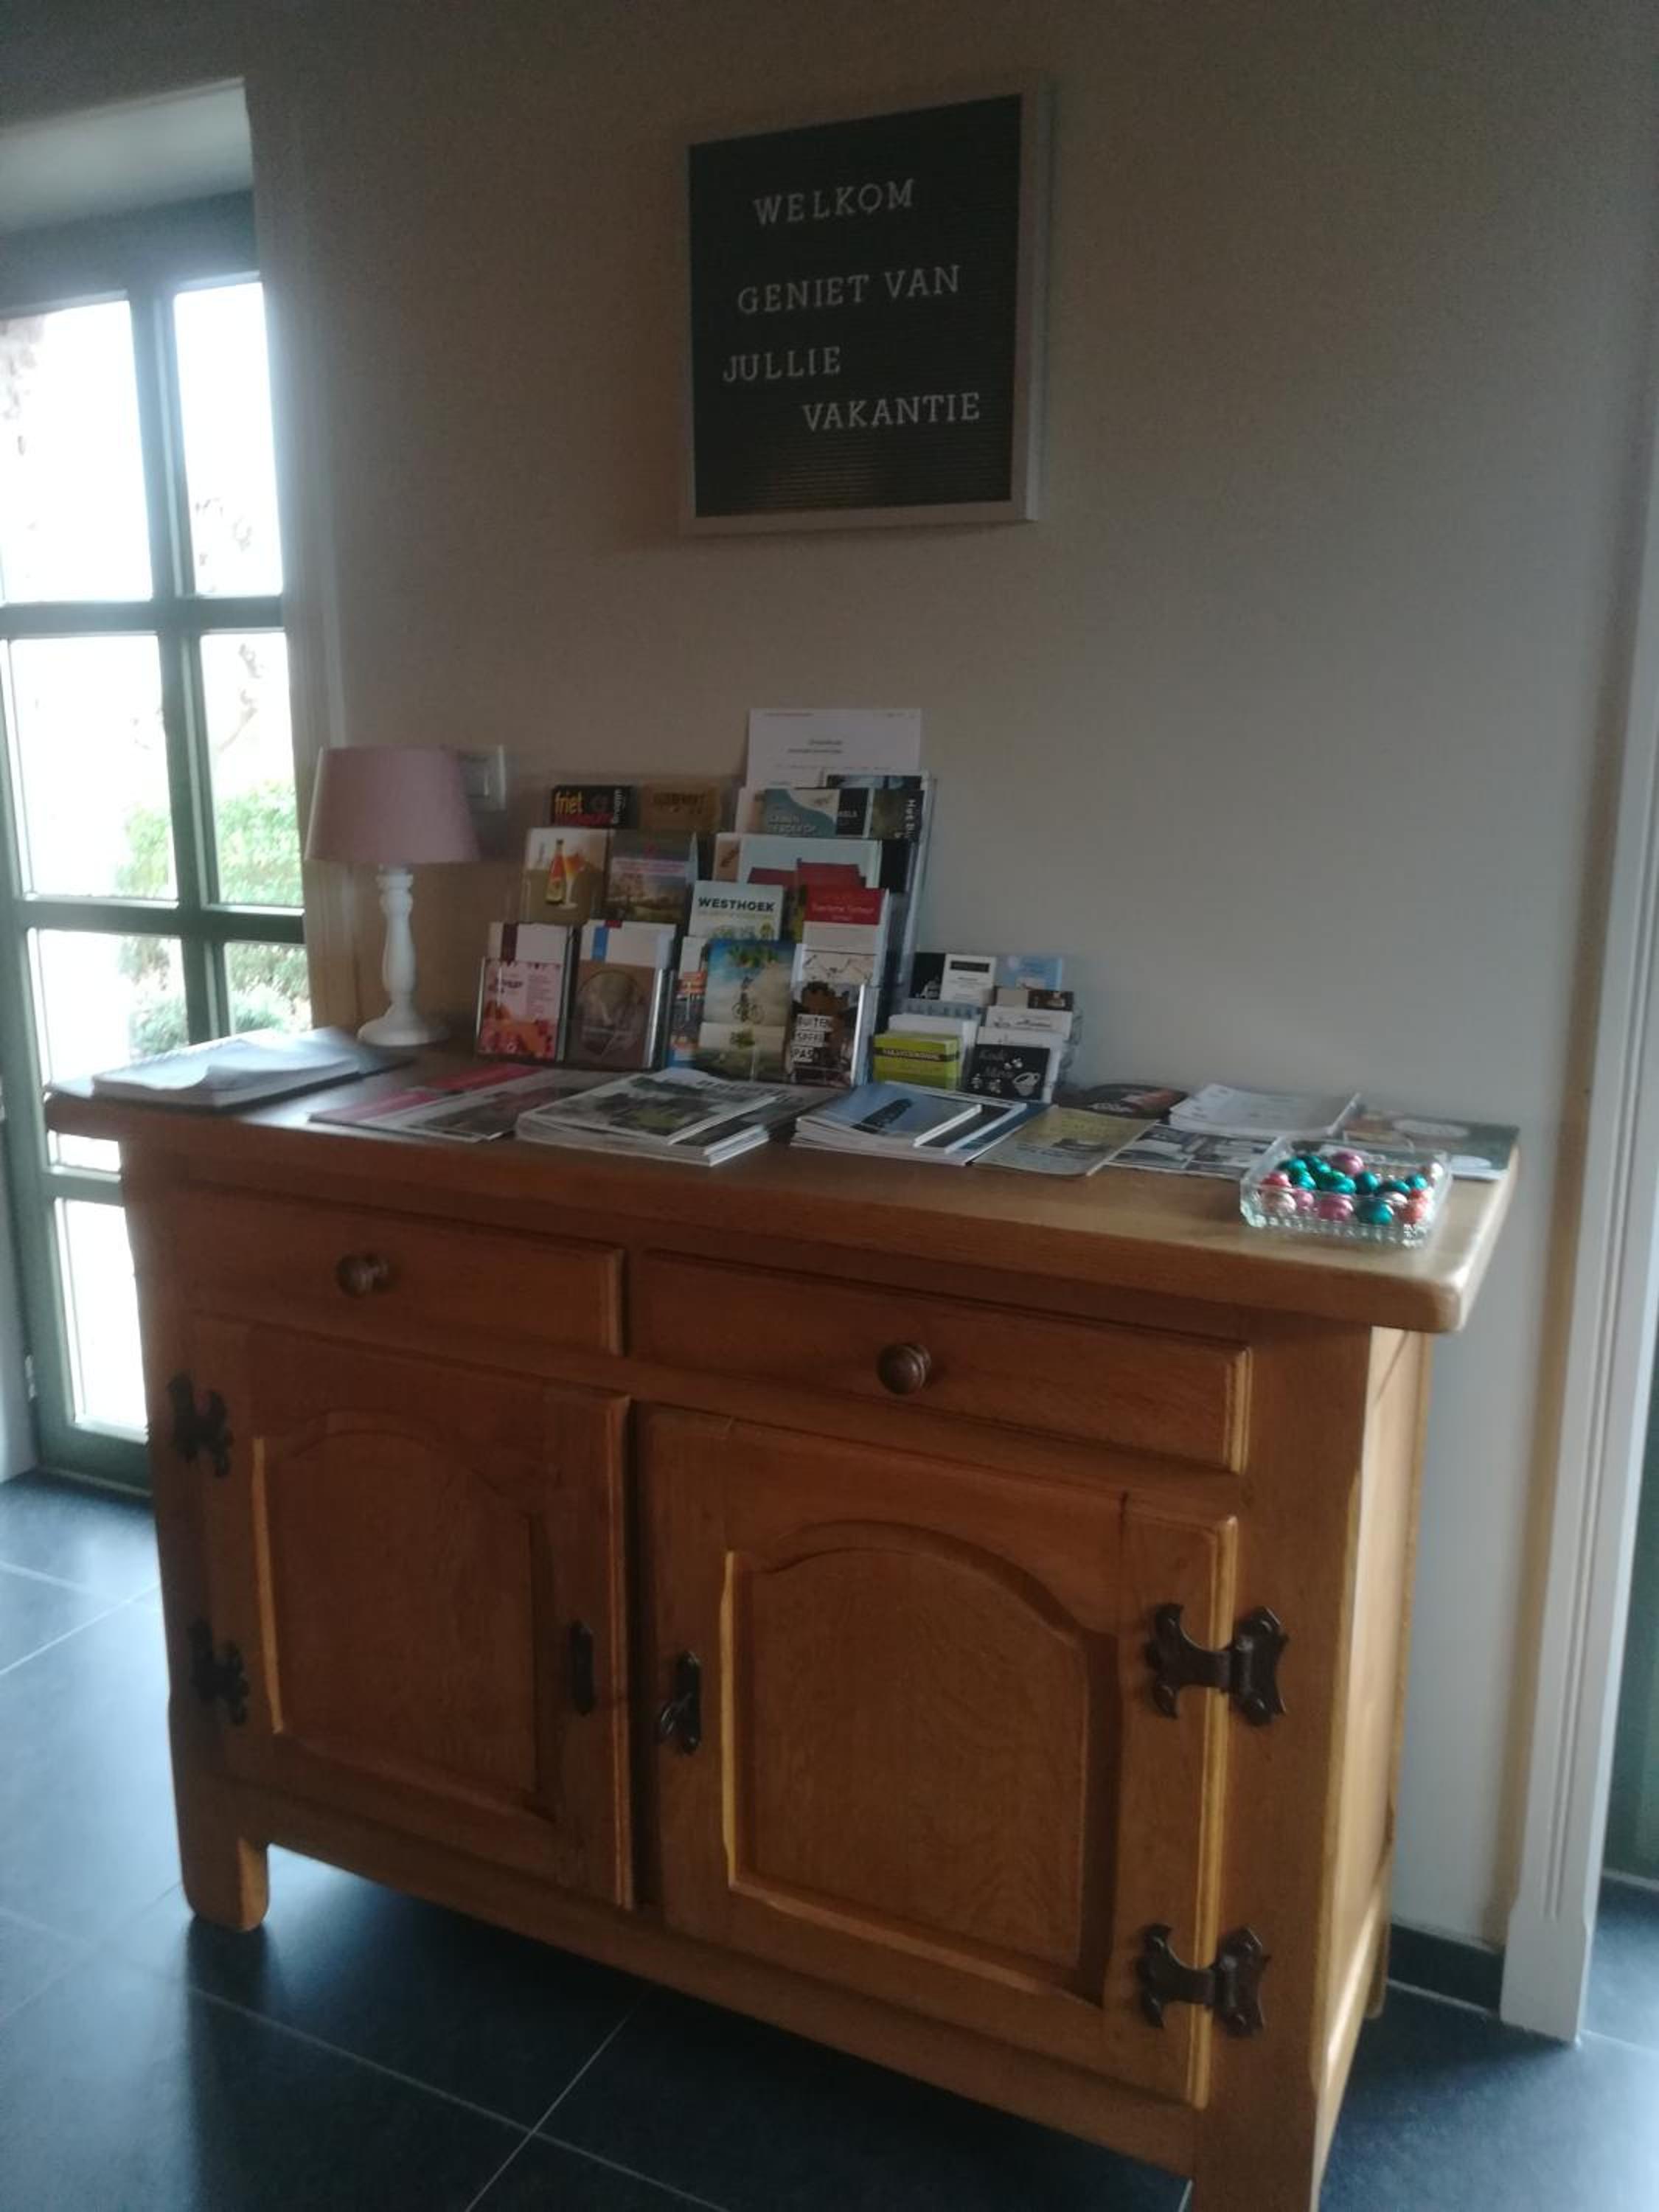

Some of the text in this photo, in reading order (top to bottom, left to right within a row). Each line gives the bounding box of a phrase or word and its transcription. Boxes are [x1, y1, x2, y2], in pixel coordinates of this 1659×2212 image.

[753, 178, 916, 226] WELKOM
[737, 264, 961, 315] GENIET VAN
[723, 346, 842, 384] JULLIE
[802, 392, 981, 433] VAKANTIE
[698, 897, 776, 914] WESTHOEK
